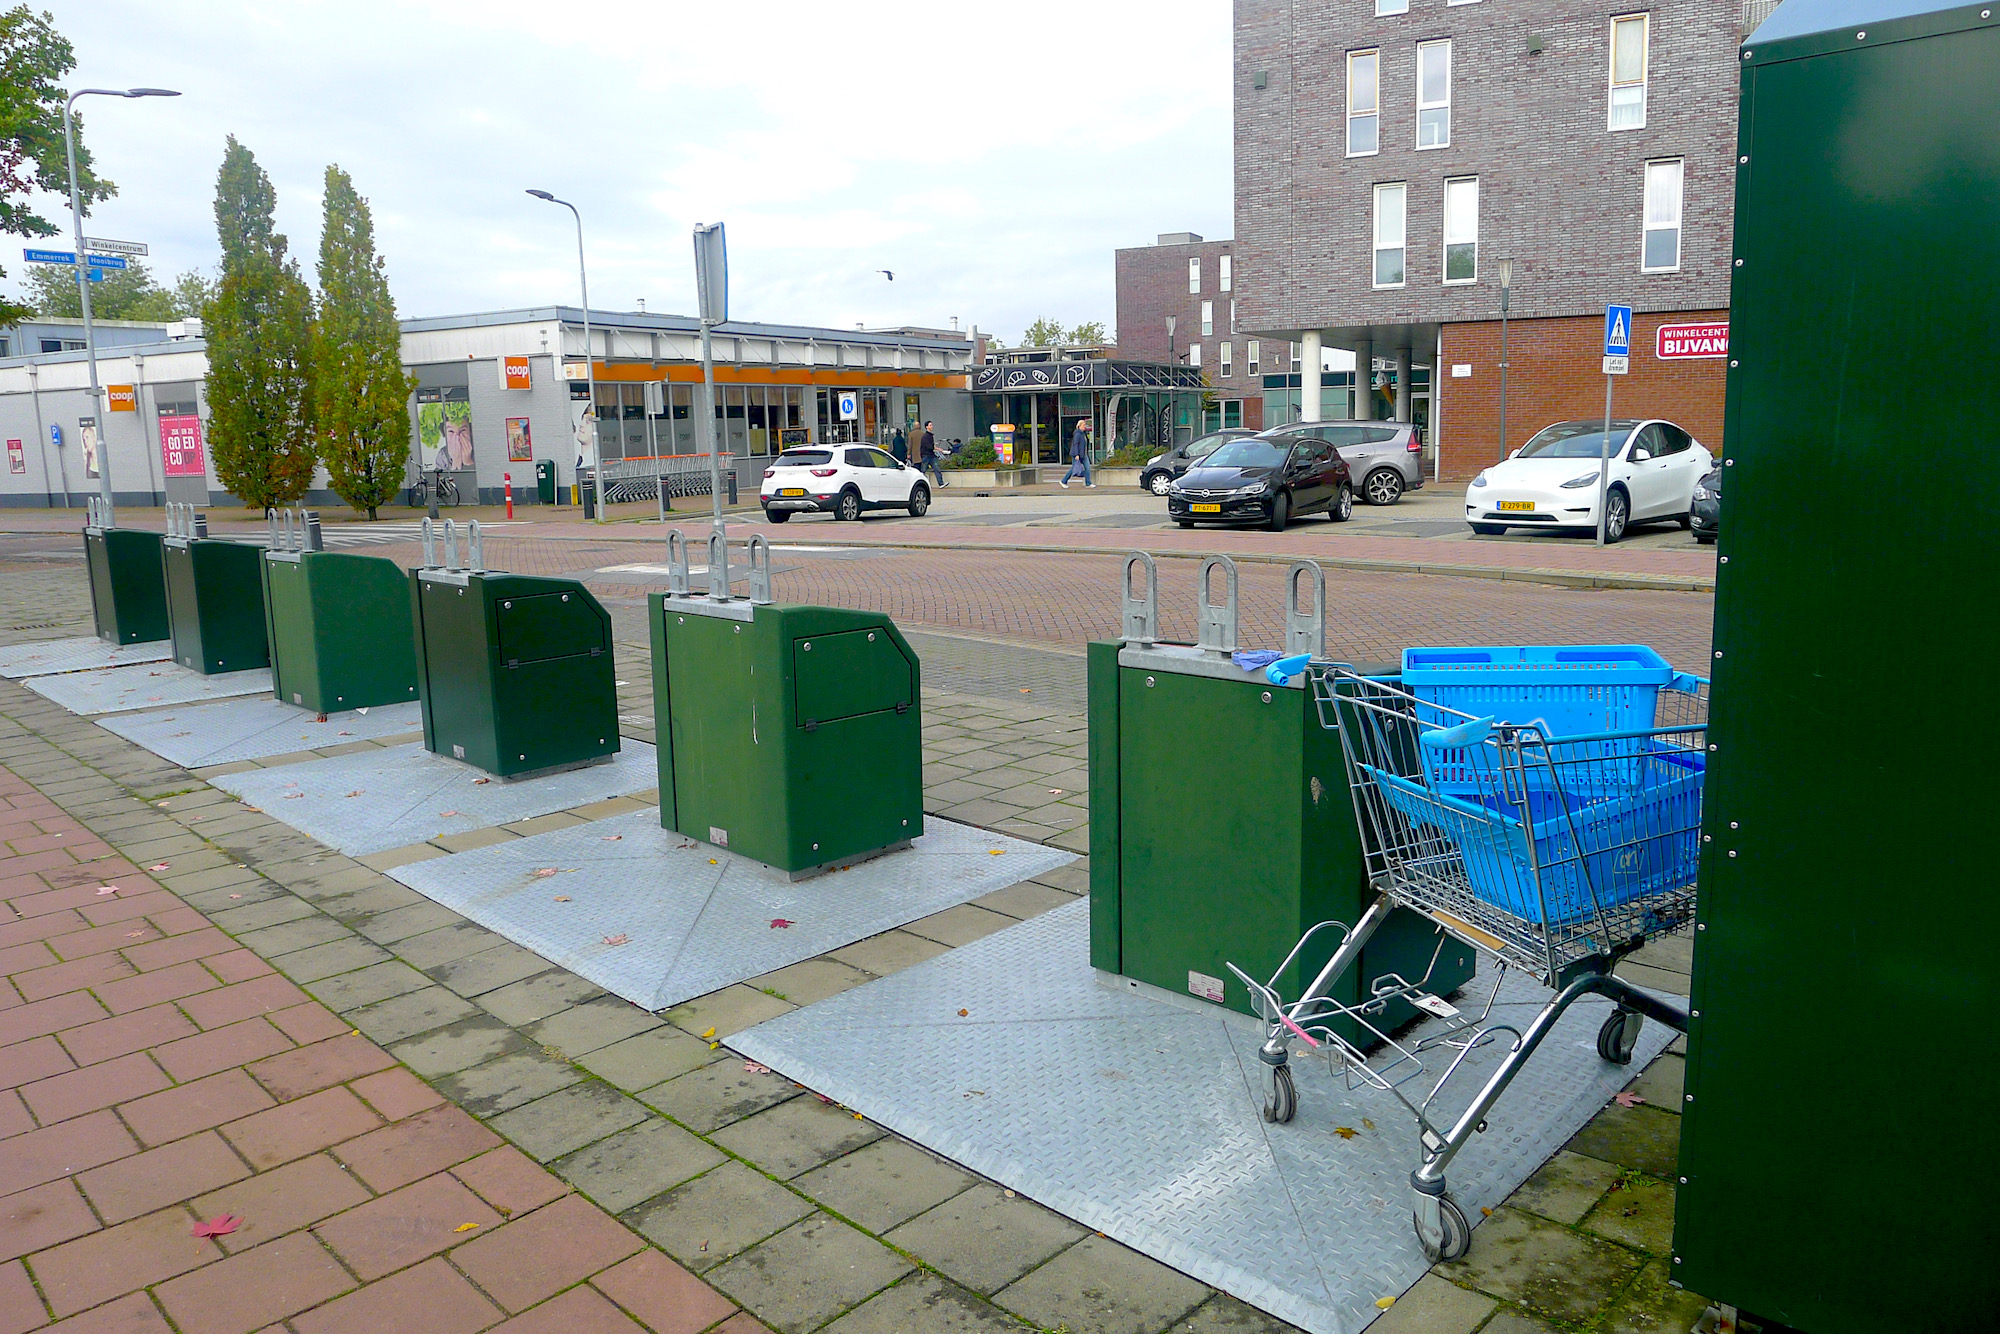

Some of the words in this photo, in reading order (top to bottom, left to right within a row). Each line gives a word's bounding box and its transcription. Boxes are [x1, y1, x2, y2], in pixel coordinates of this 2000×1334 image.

[91, 240, 143, 253] Winkelcentrum
[32, 252, 70, 262] Emmerrek
[90, 256, 124, 268] Hooibrug
[1664, 328, 1728, 338] WINKELCENT
[1664, 339, 1729, 354] BIJVAN
[506, 365, 528, 378] coop
[110, 392, 133, 402] coop
